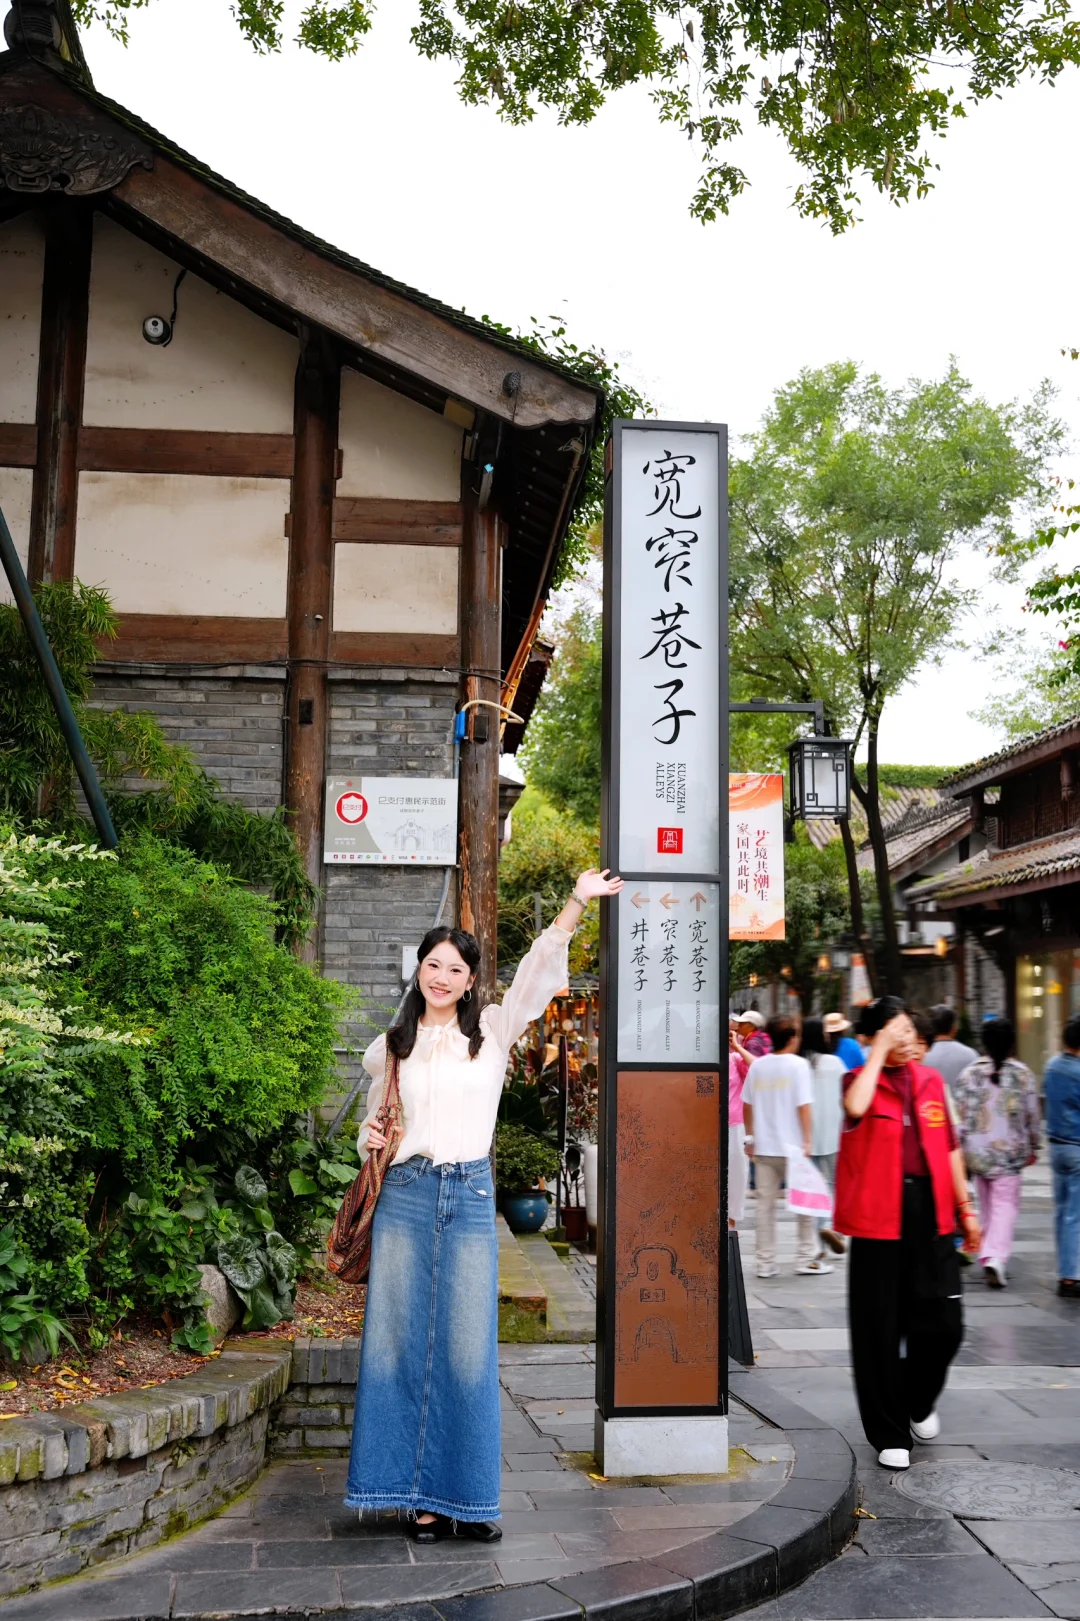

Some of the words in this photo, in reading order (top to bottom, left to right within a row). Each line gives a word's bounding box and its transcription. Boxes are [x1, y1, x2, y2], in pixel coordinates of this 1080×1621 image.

[639, 449, 702, 745] 宽窄巷子
[655, 761, 664, 799] ALLEYS
[666, 762, 675, 803] XIANGZI
[676, 762, 686, 814] KUANZHAI
[736, 822, 752, 894] 家国共此时
[753, 829, 770, 902] 艺境共潮生
[630, 918, 650, 992] 井巷子
[659, 918, 680, 992] 窄巷子
[688, 919, 709, 993] 宽巷子
